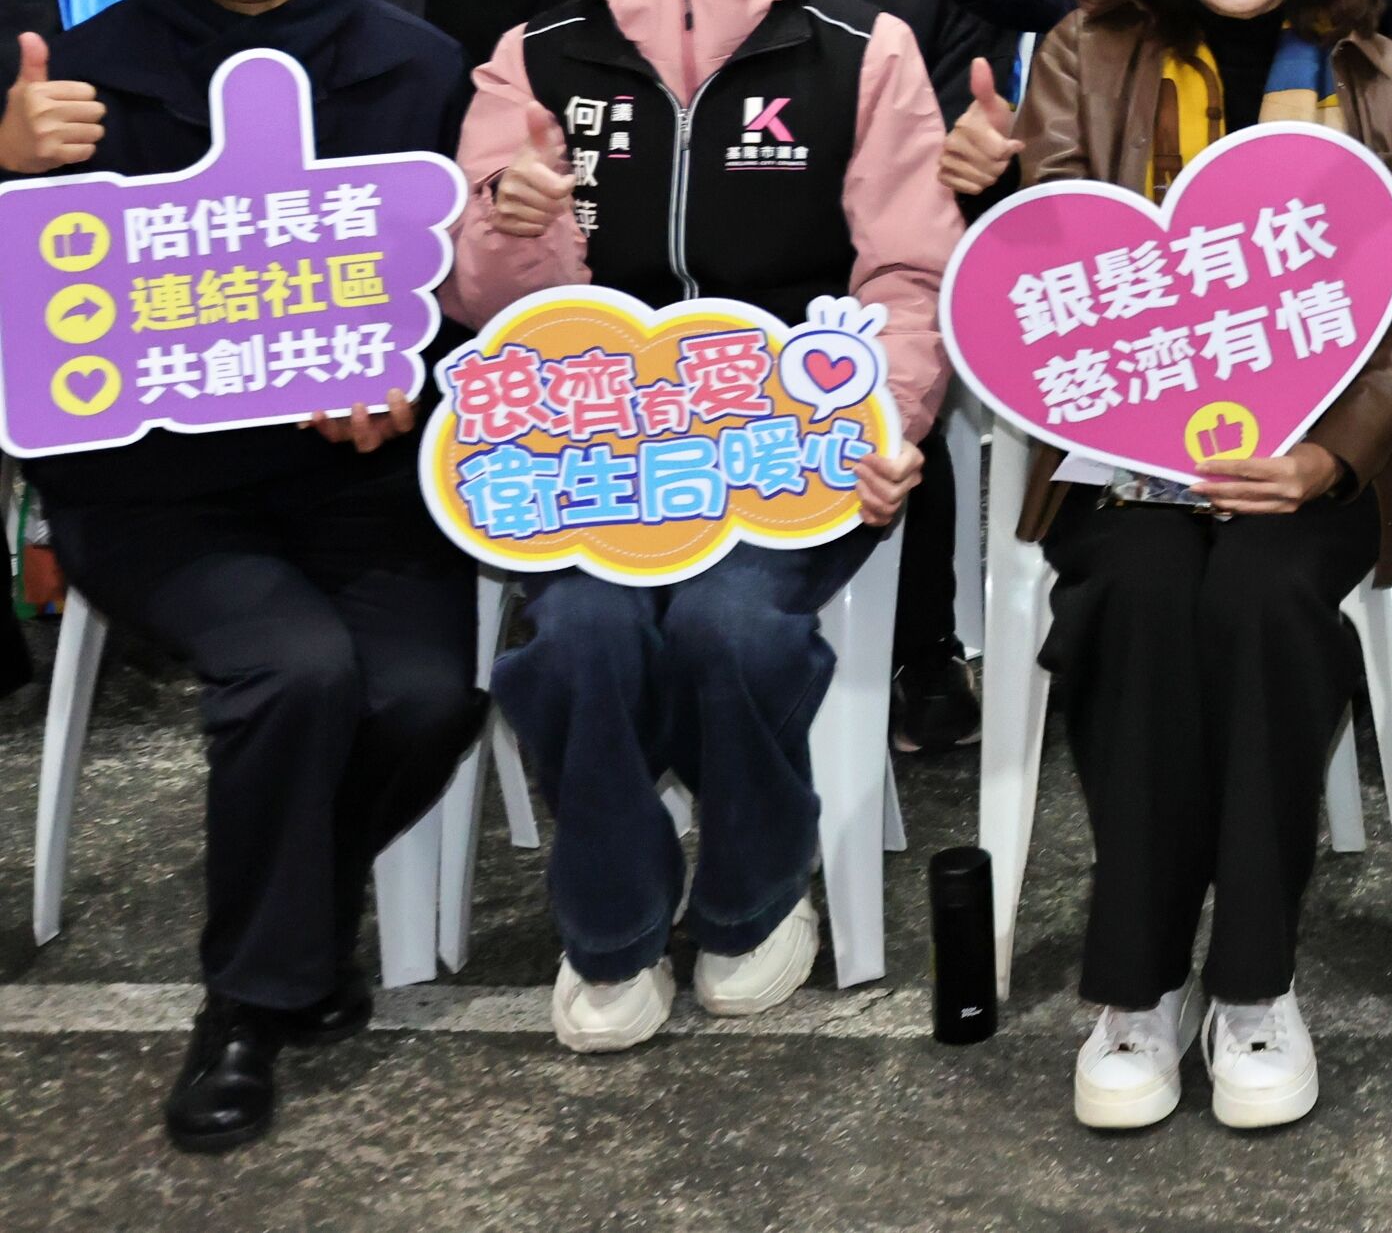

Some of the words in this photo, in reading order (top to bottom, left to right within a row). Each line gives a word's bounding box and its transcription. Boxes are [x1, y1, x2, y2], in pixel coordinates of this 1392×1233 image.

[725, 146, 809, 159] 基隆市議會
[124, 183, 382, 262] 陪伴長者
[131, 252, 388, 335] 連結社區
[1009, 199, 1336, 347] 銀髮有依
[136, 323, 395, 404] 共創共好
[451, 331, 772, 444] 慈濟有愛
[1034, 279, 1356, 425] 慈濟有情
[461, 418, 874, 538] 衛生局暖心
